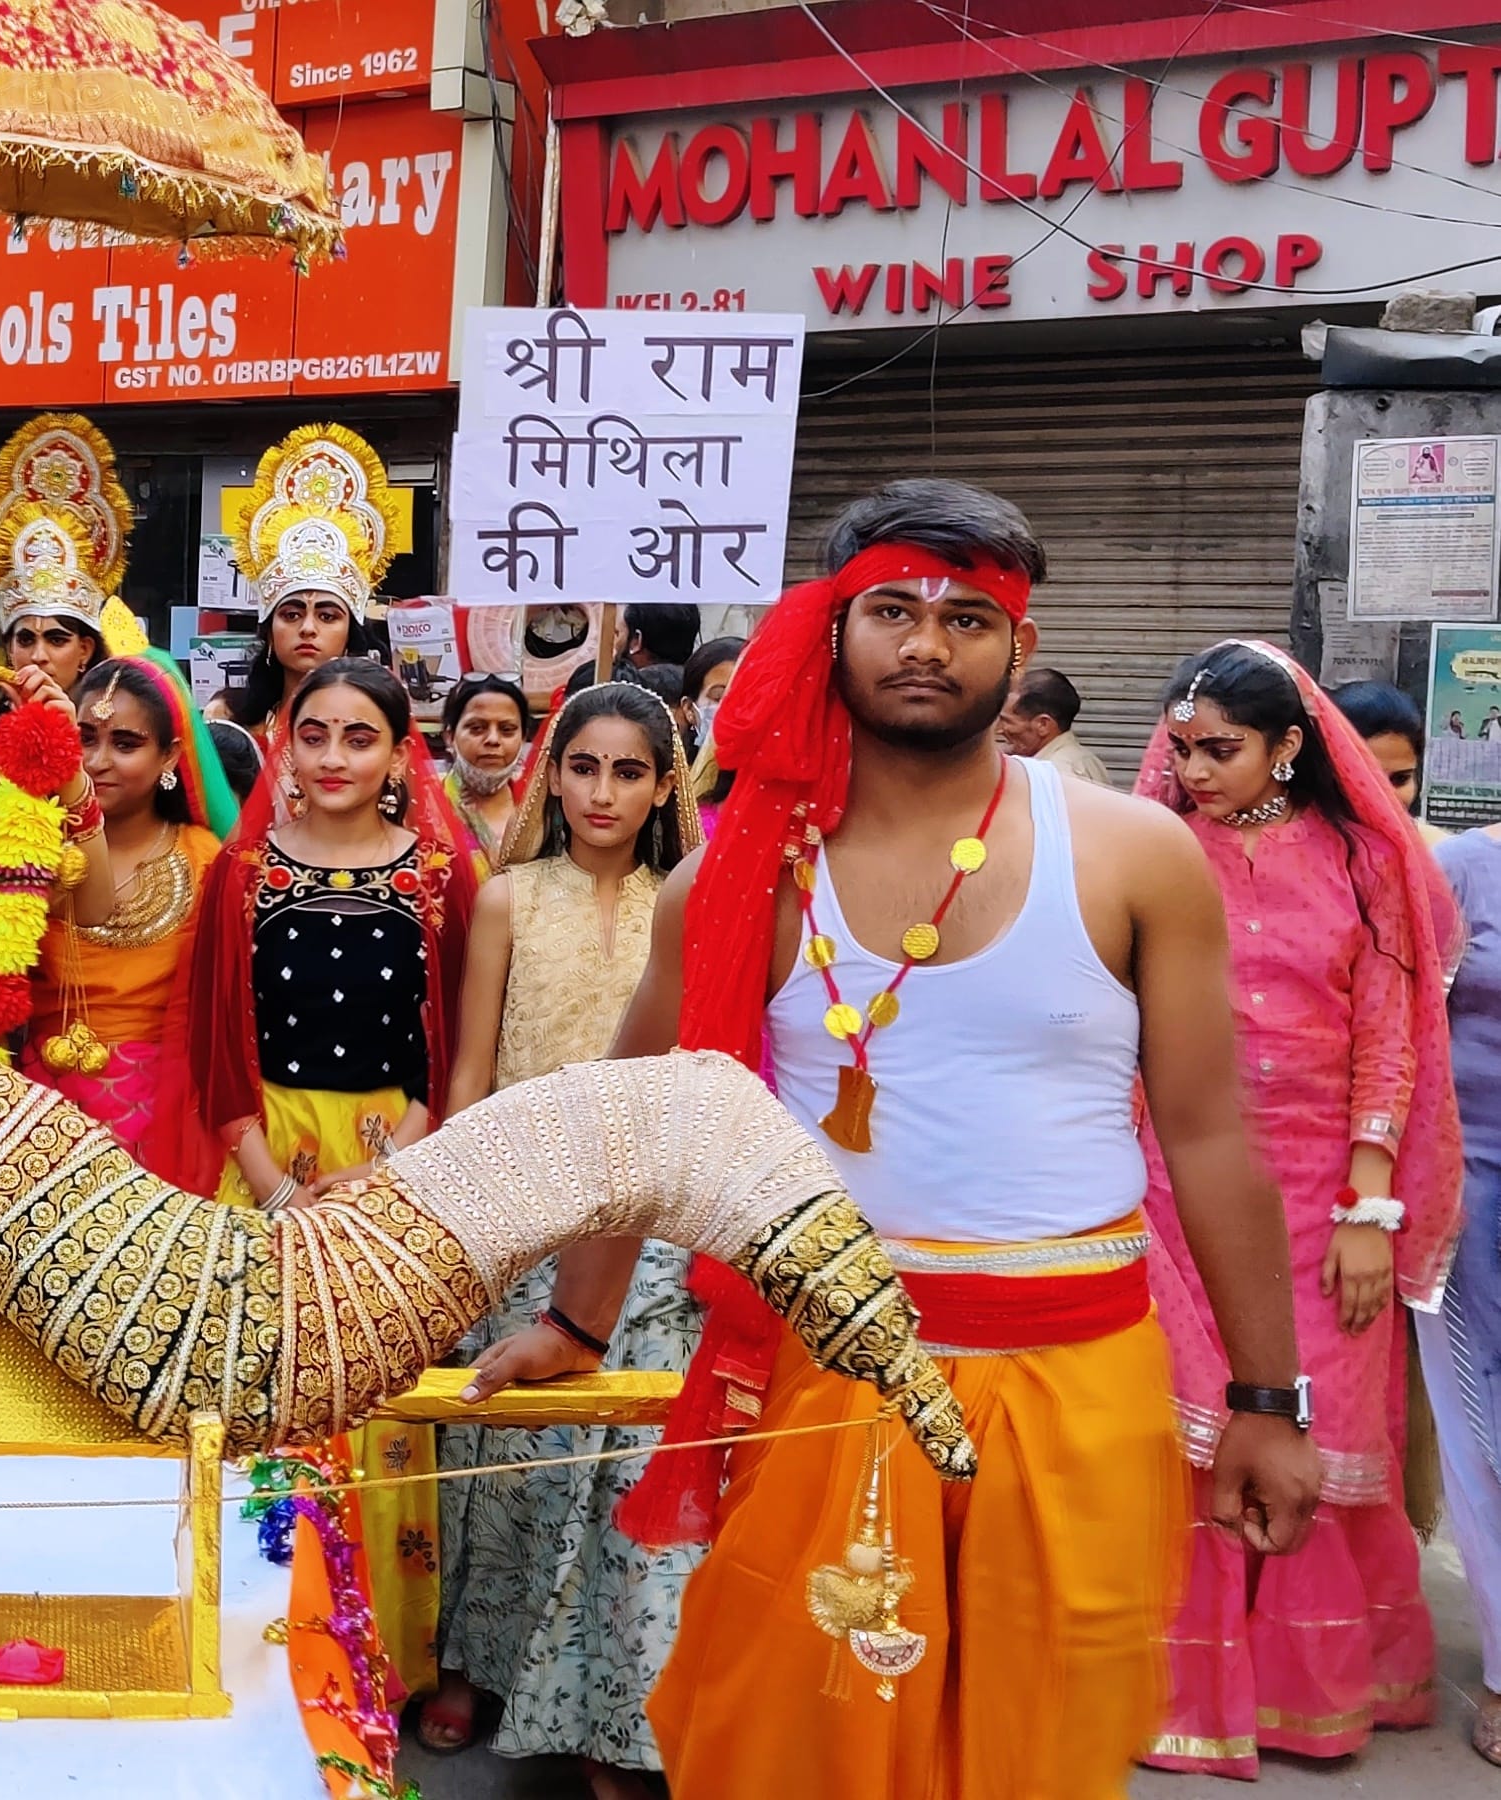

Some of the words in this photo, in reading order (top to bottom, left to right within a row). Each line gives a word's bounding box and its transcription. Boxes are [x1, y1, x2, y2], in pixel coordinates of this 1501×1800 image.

[289, 62, 353, 88] Since
[360, 47, 418, 78] 1962
[605, 78, 1184, 233] MOHANLAL
[1199, 45, 1501, 183] GUPT
[811, 254, 1014, 316] WINE
[1086, 233, 1323, 301] SHOP
[92, 283, 238, 362] Tiles
[503, 309, 607, 404] श्री
[643, 336, 795, 403] राम
[114, 365, 162, 389] GST
[167, 363, 209, 388] NO.
[213, 351, 441, 386] 01BRBPG8261L1ZW
[502, 413, 743, 489] मिथिला
[477, 500, 579, 593] की
[627, 498, 768, 590] ओर
